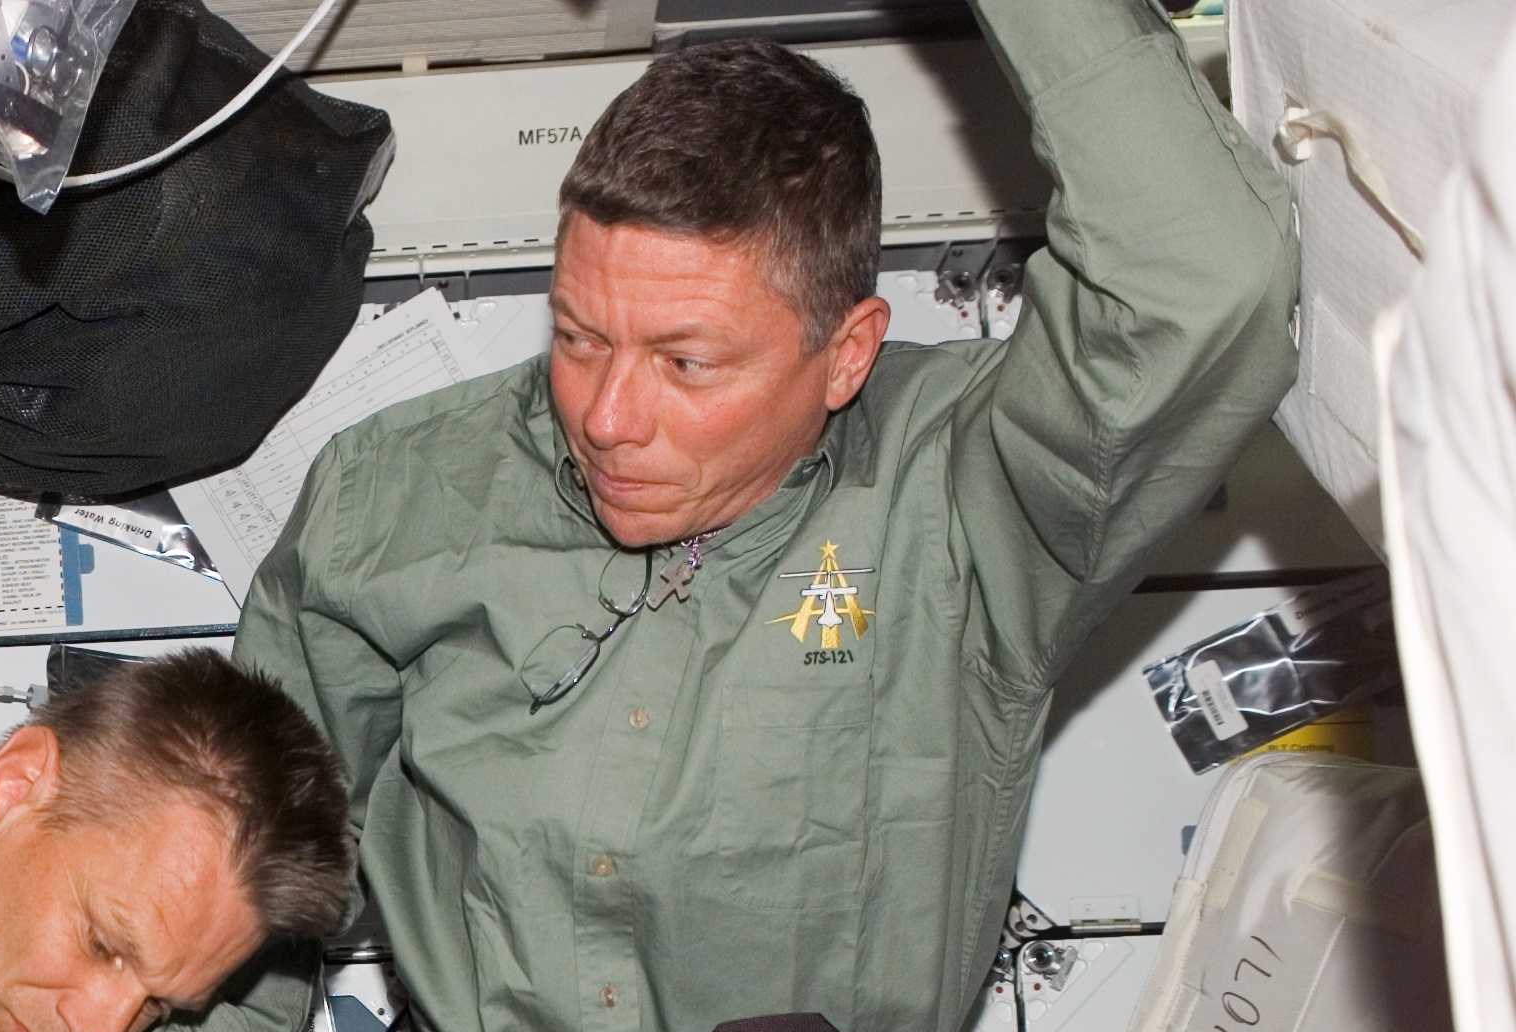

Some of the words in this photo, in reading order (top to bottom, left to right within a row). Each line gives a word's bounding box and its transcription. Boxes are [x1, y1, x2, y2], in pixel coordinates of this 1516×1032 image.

[518, 126, 582, 145] MF57A
[75, 508, 104, 523] Water
[108, 517, 153, 538] Drinking
[804, 650, 853, 665] STS-121
[1291, 743, 1335, 752] Clothing
